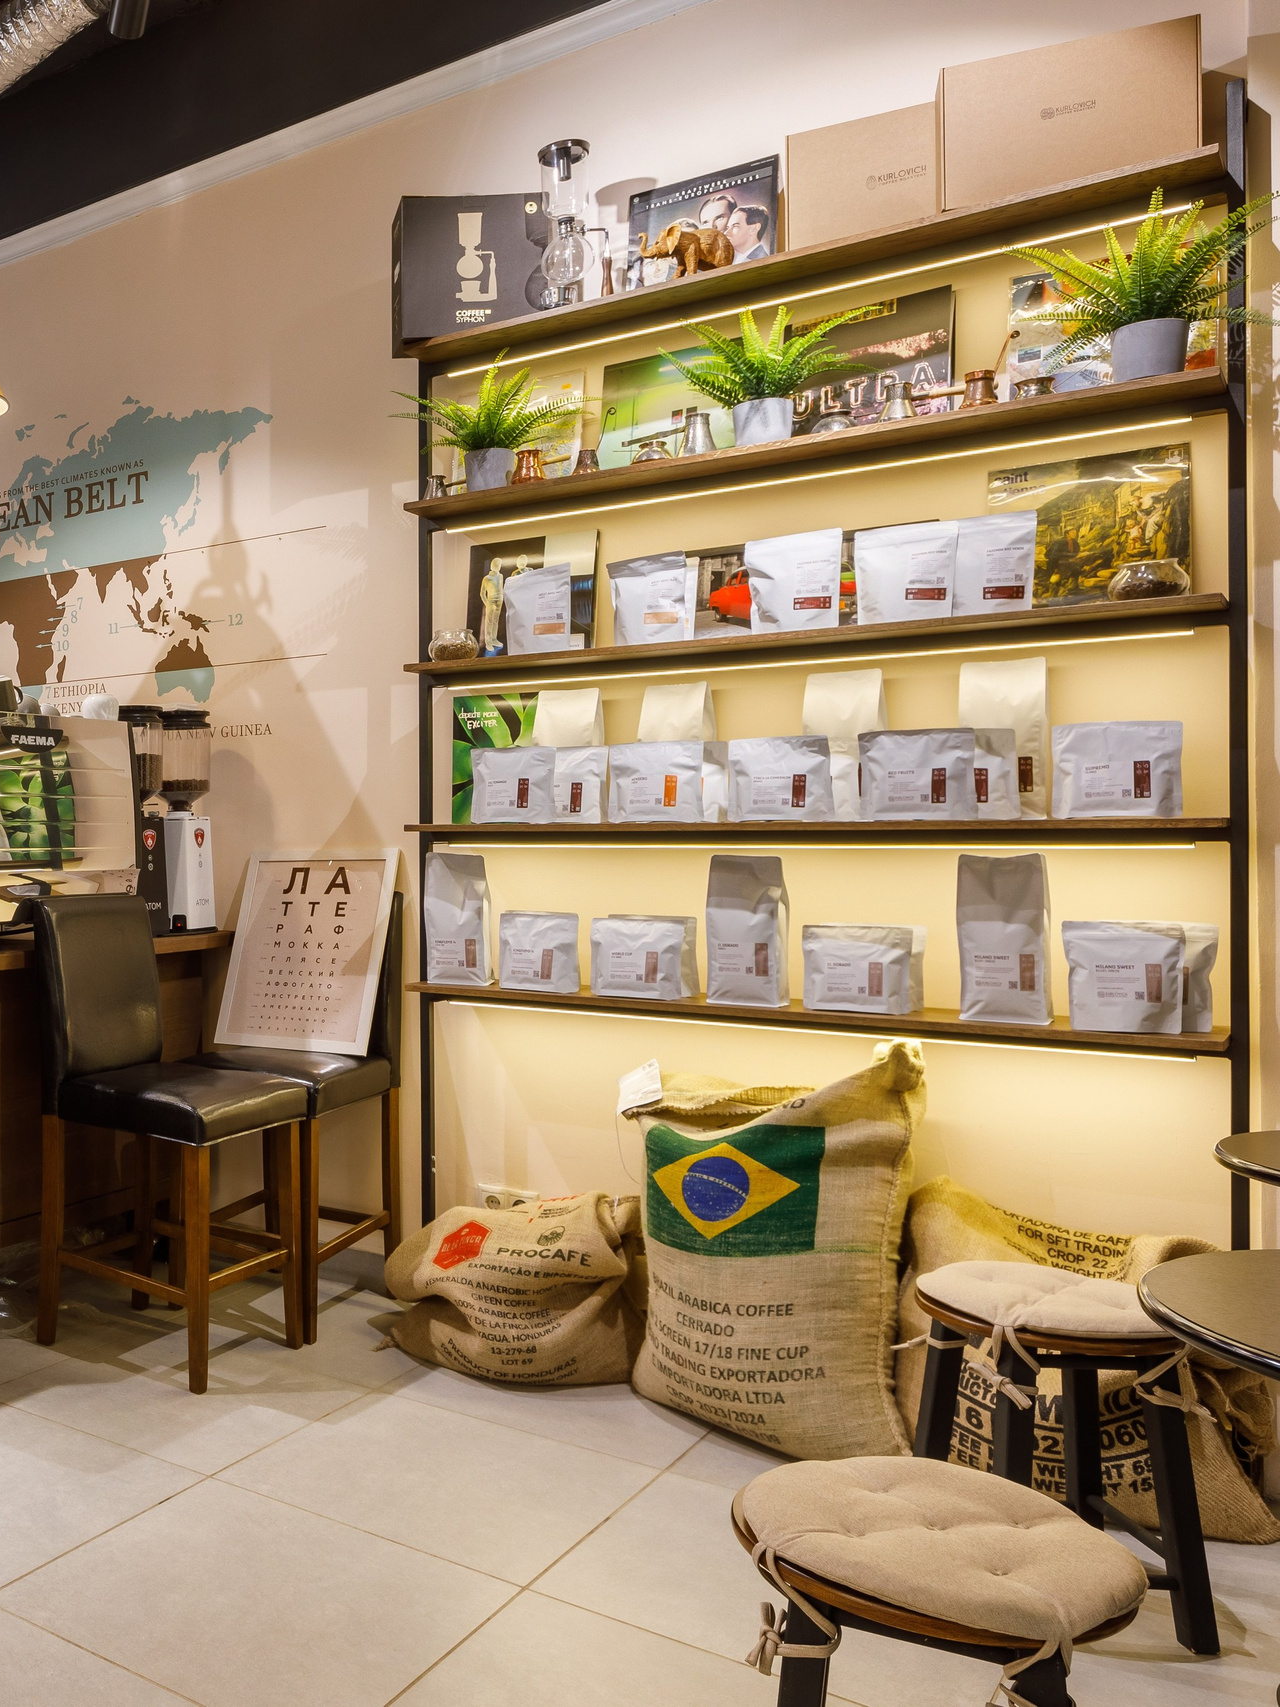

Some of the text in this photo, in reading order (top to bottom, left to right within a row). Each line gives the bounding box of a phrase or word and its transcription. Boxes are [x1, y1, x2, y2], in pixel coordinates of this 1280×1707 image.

[1056, 100, 1096, 113] KURLOVICH
[878, 165, 926, 182] KURLOVICH
[793, 362, 936, 421] ULTRA
[4, 488, 24, 499] FROM
[25, 483, 39, 493] THE
[41, 478, 59, 490] BEST
[61, 470, 98, 485] CLIMATES
[100, 463, 132, 476] KNOWN
[133, 459, 144, 468] AS
[64, 471, 148, 519] BELT
[76, 597, 84, 610] 7
[71, 610, 78, 624] 8
[228, 613, 243, 626] 12
[62, 623, 69, 637] 9
[108, 623, 119, 634] 11
[56, 640, 70, 651] 10
[53, 683, 107, 698] ETHIOPIA
[220, 723, 272, 738] GUINEA
[11, 734, 55, 746] FAEMA
[1017, 1225, 1071, 1248] FOR SFT
[497, 1247, 592, 1267] PROCAFÉ
[1047, 1248, 1085, 1265] CROP
[468, 1262, 531, 1278] EXPORTAÇÃO
[476, 1282, 530, 1295] ANAEROBIC
[471, 1293, 537, 1307] GREEN COFFEE
[677, 1291, 731, 1315] ARABICA
[736, 1303, 794, 1317] COFFEE
[478, 1306, 518, 1320] ARABICA
[520, 1308, 550, 1320] COFFEE
[475, 1317, 486, 1327] DE
[489, 1320, 501, 1329] LA
[676, 1312, 735, 1337] CERRADO
[512, 1322, 561, 1342] HONDURAS
[659, 1320, 809, 1360] SCREEN 17/18 FINE CUP
[448, 1338, 492, 1374] PRODUCT
[511, 1356, 577, 1379] HONDURAS
[491, 1346, 537, 1356] 13-279-68
[661, 1341, 826, 1383] TRADING EXPORTADORA
[556, 1367, 579, 1381] ONLY
[657, 1357, 785, 1404] IMPORTADORA LTDA
